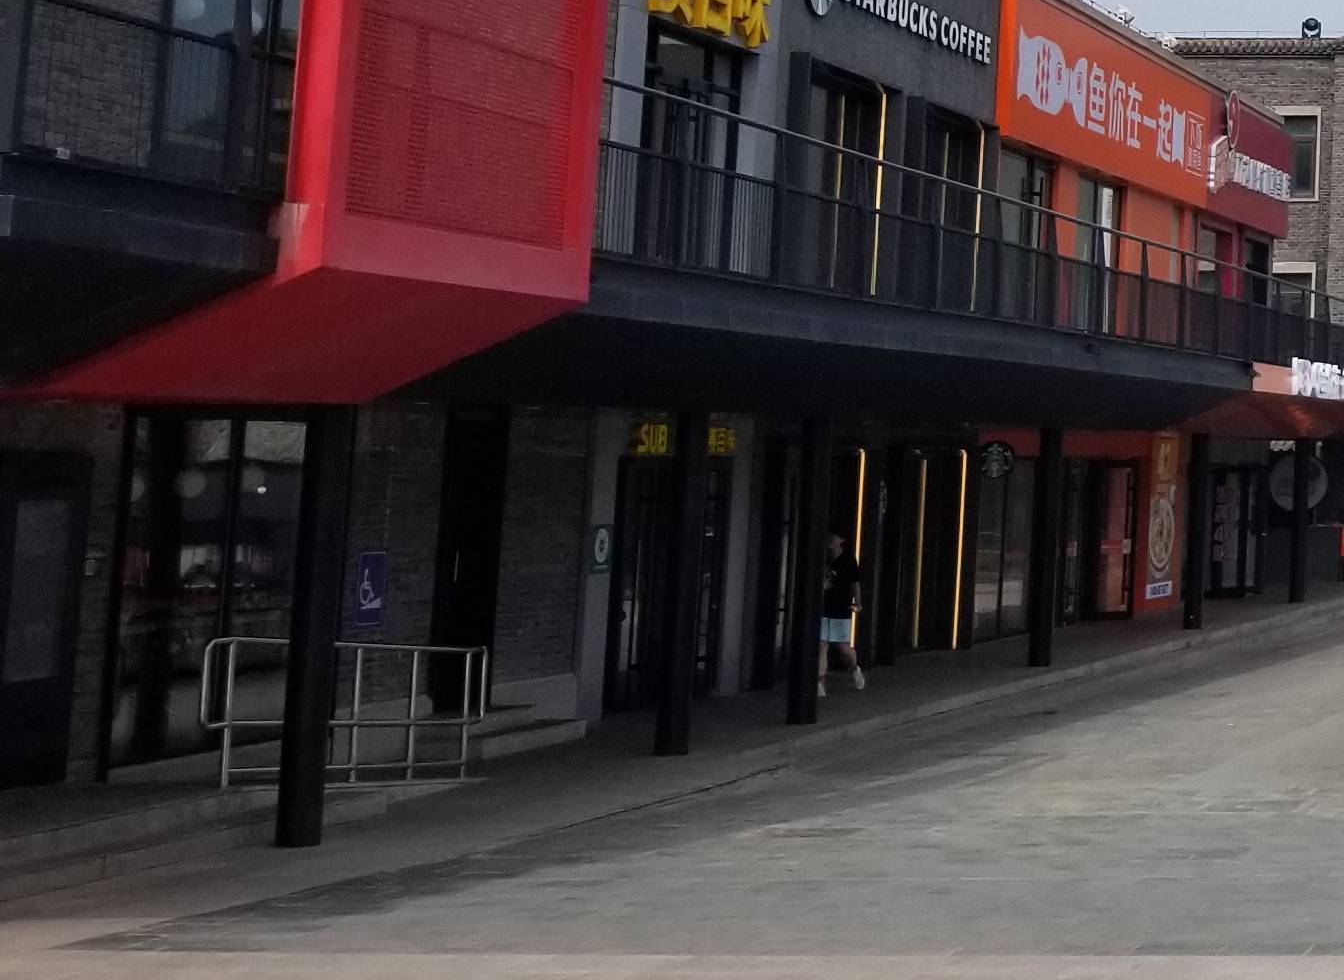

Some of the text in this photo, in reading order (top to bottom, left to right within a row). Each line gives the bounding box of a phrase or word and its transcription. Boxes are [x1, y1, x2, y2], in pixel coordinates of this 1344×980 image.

[940, 16, 991, 64] COFFEE
[1088, 62, 1173, 163] 鱼你在一起
[635, 423, 672, 454] SUB
